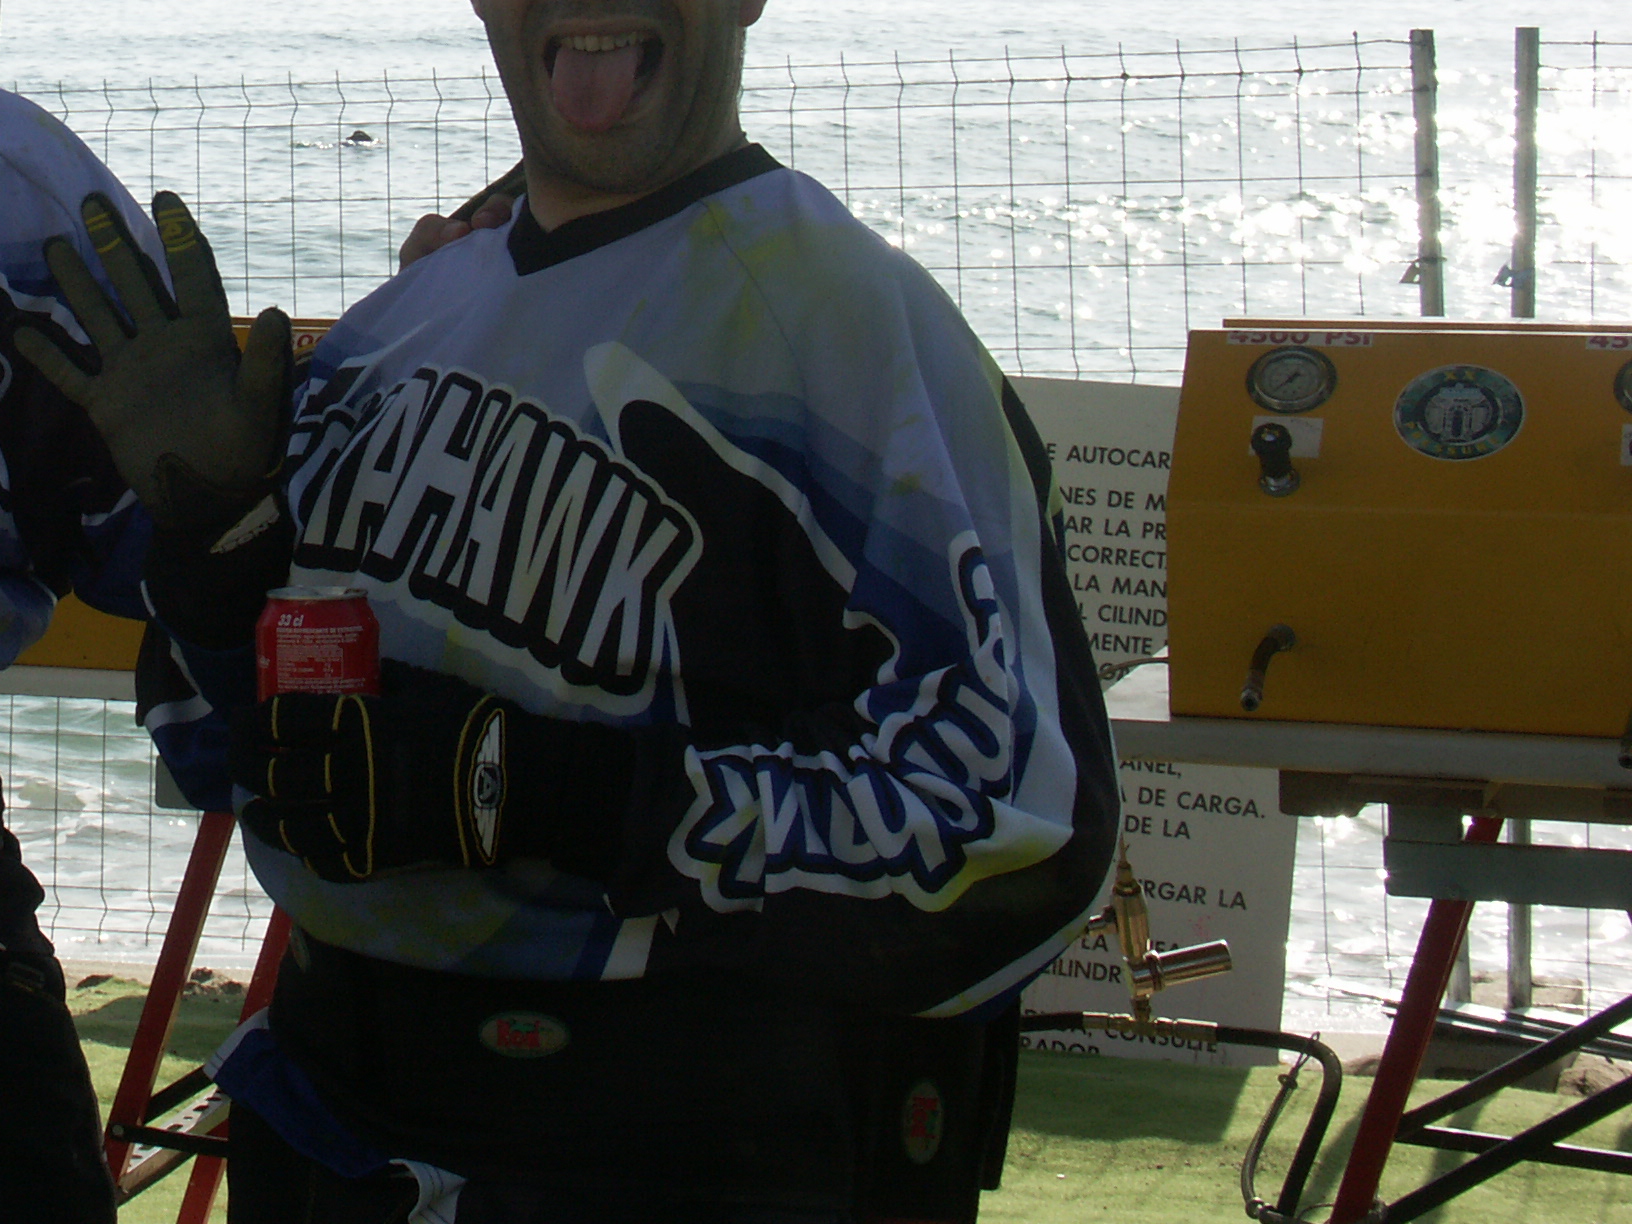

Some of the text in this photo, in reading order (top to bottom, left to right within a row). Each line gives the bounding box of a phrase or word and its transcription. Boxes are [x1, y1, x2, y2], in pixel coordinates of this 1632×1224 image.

[1066, 445, 1171, 469] AUTOCAR
[1107, 490, 1135, 509] DE
[1104, 519, 1130, 537] LA
[1067, 544, 1167, 569] CORRECT
[1074, 573, 1101, 593] LA
[277, 613, 292, 626] 33
[1138, 786, 1266, 819] DE CARGA.
[1125, 815, 1191, 840] DE LA
[1139, 878, 1247, 911] RGAR LA
